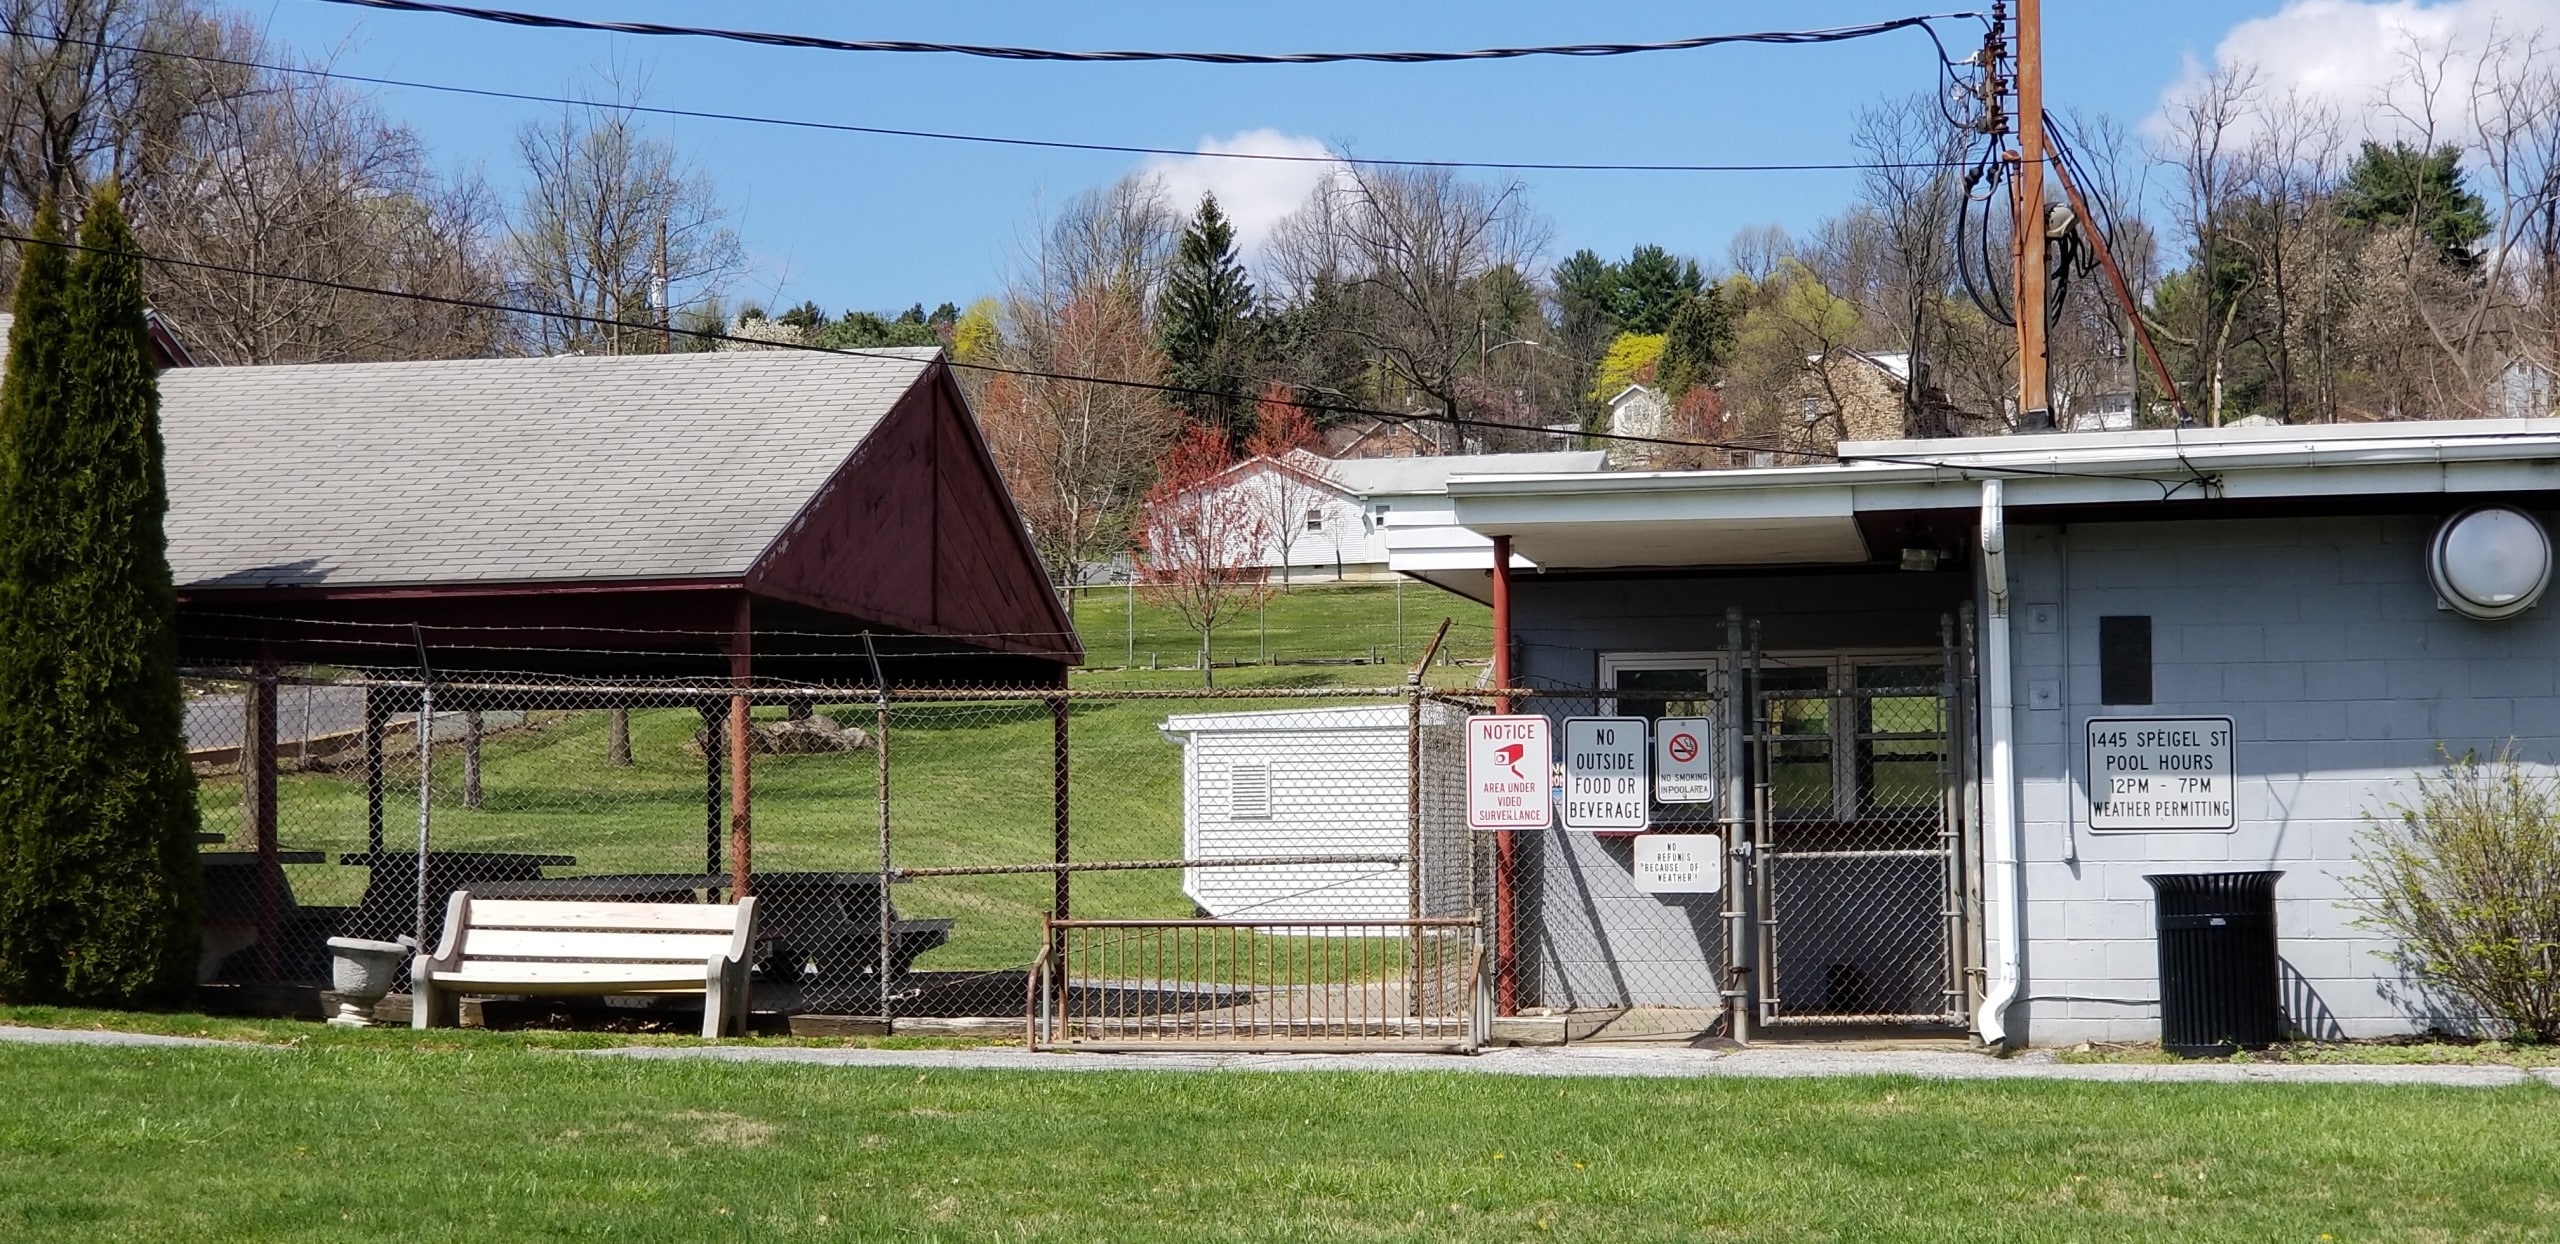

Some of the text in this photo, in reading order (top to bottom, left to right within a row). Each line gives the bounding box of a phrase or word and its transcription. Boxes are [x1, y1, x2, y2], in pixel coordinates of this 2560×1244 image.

[1483, 724, 1535, 740] NOTICE
[1596, 728, 1615, 746] NO
[2092, 730, 2228, 748] 1445 SPEIGEL ST
[1576, 752, 1635, 770] OUTSIDE
[2106, 754, 2214, 771] POOL HOURS
[1575, 777, 1611, 794] FOOD
[1617, 777, 1636, 794] OR
[1660, 772, 1708, 782] NO SMOKING
[2110, 778, 2149, 794] 12PM
[2178, 777, 2212, 793] 7PM
[1483, 782, 1536, 793] AREA UNDER
[1497, 796, 1522, 807] VIDEO
[1569, 801, 1641, 819] BEVERAGE
[2093, 800, 2230, 817] WEATHER PERMITTING
[1479, 809, 1541, 821] SURVEILLANCE
[1667, 842, 1677, 852] NO
[1644, 862, 1699, 873] BECAUSE OF
